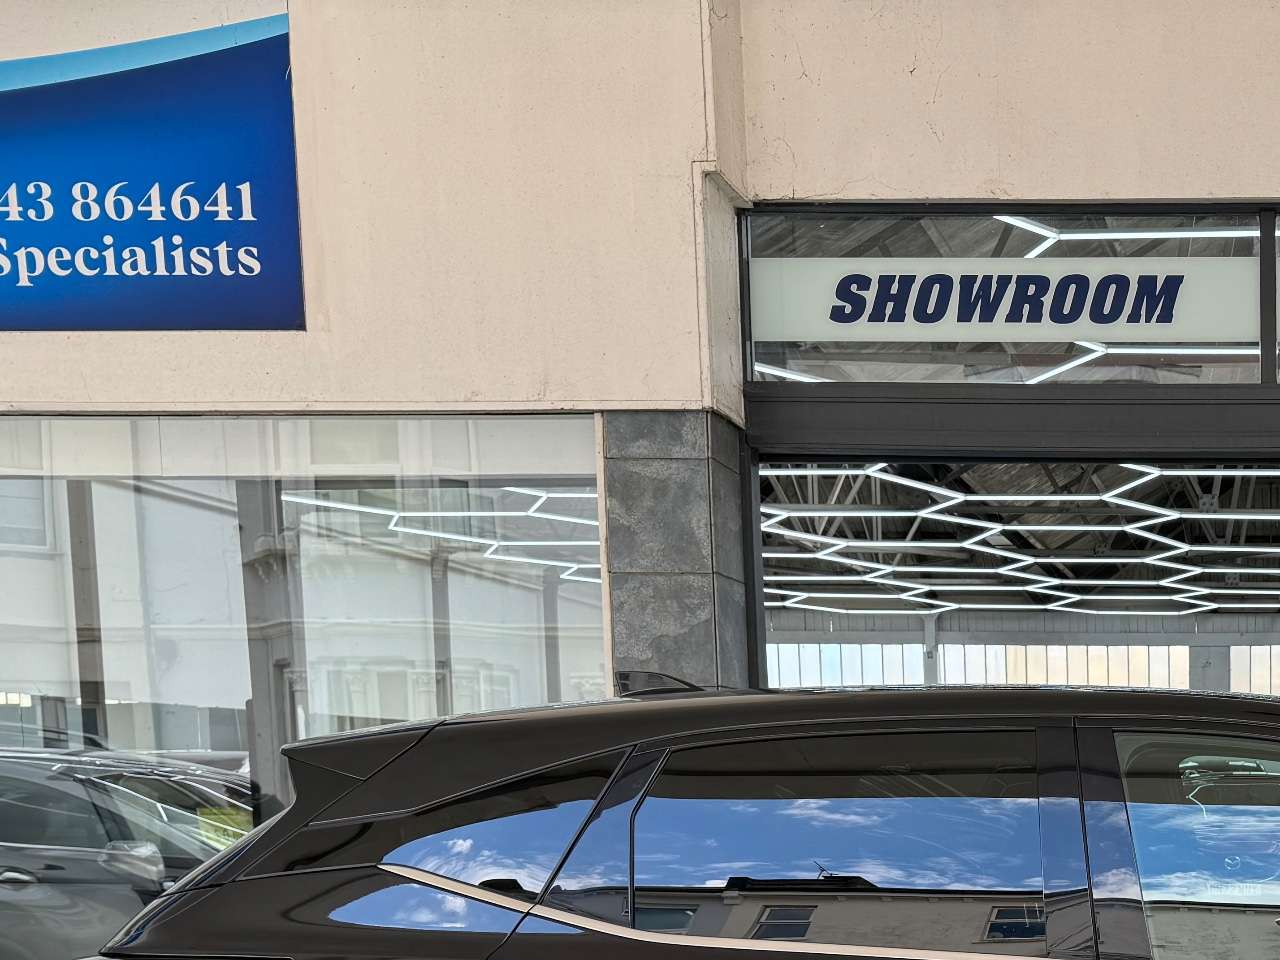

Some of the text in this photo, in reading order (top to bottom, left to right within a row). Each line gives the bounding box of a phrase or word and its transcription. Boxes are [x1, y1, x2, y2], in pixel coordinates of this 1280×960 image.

[0, 181, 258, 222] 43 864641
[829, 273, 1185, 325] SHOWROOM
